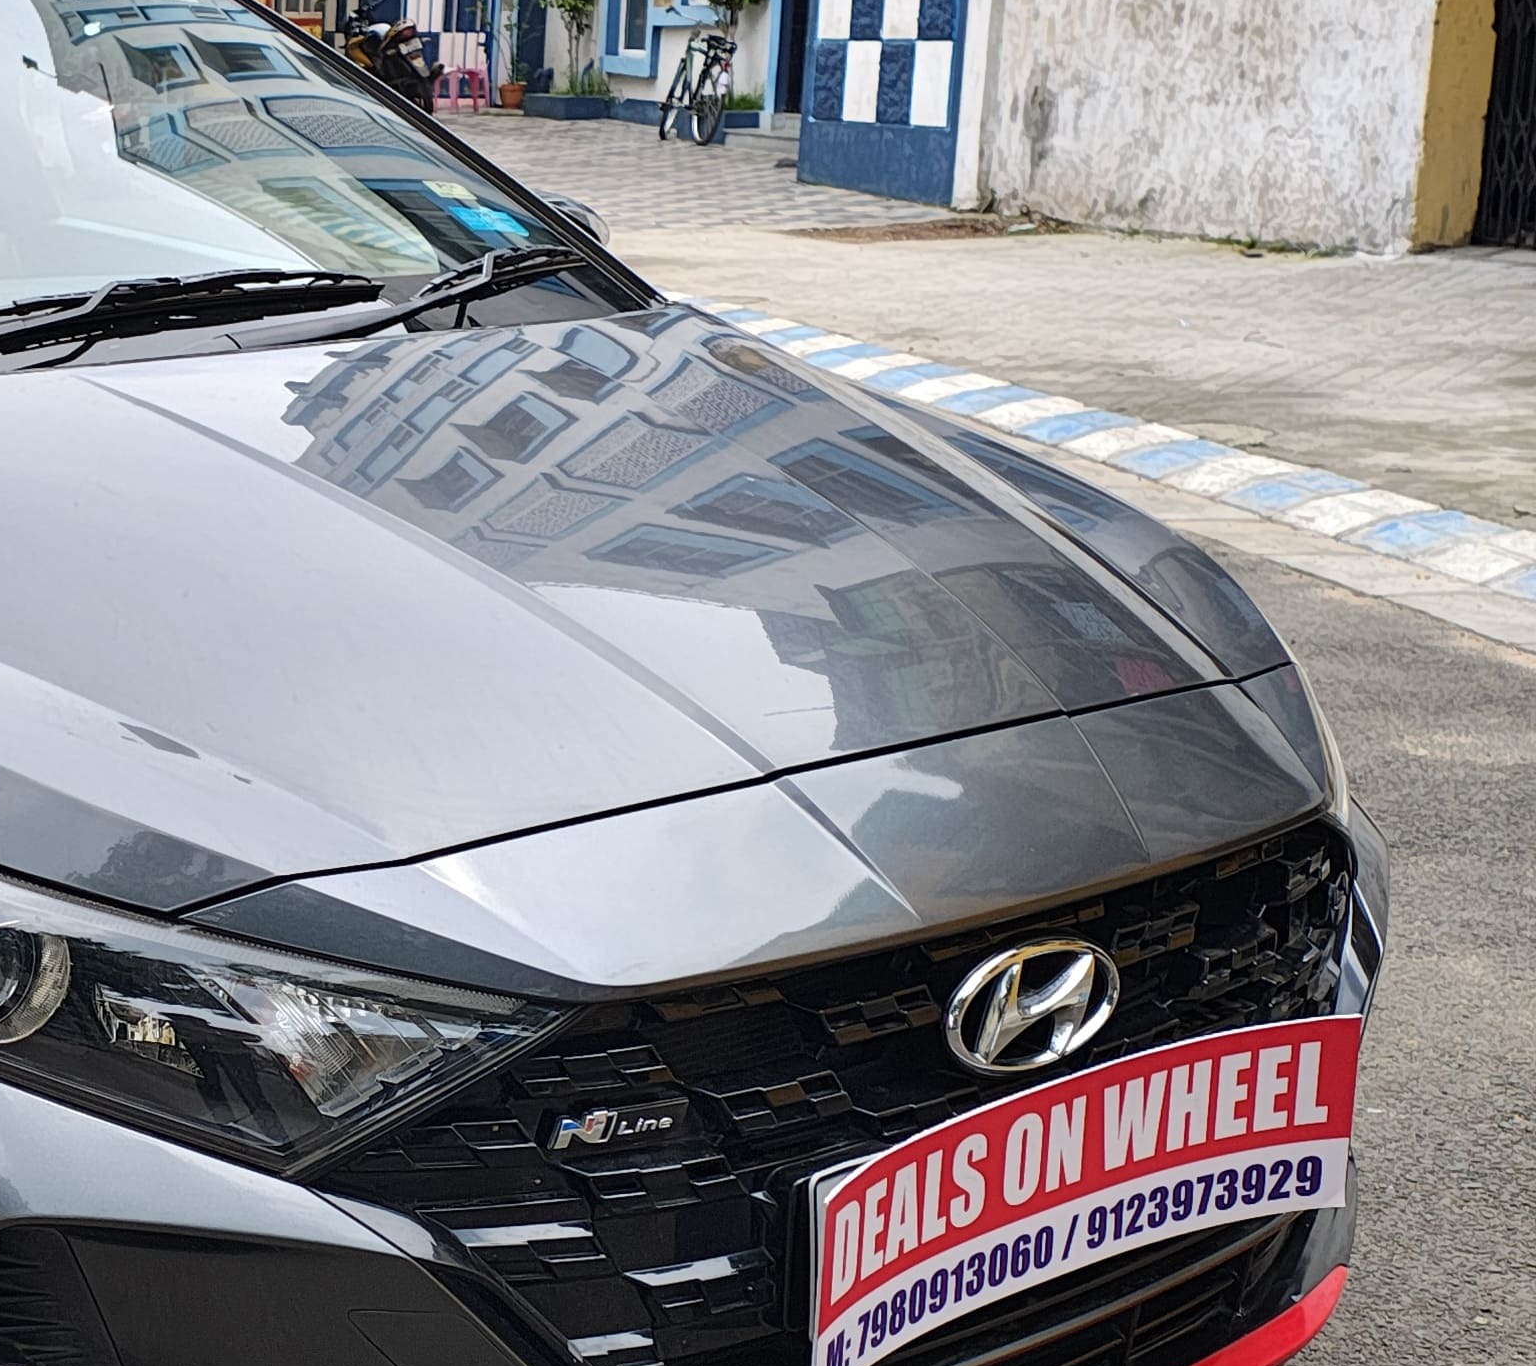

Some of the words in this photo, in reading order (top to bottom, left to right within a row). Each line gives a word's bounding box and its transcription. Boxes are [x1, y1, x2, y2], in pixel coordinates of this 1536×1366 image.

[617, 1115, 673, 1136] Line
[829, 1132, 988, 1307] DEALS
[1002, 1094, 1087, 1208] ON
[1103, 1041, 1328, 1172] WHEEL
[856, 1225, 1054, 1356] 7980913060
[1060, 1213, 1079, 1261] /
[1087, 1155, 1323, 1251] 9123973929
